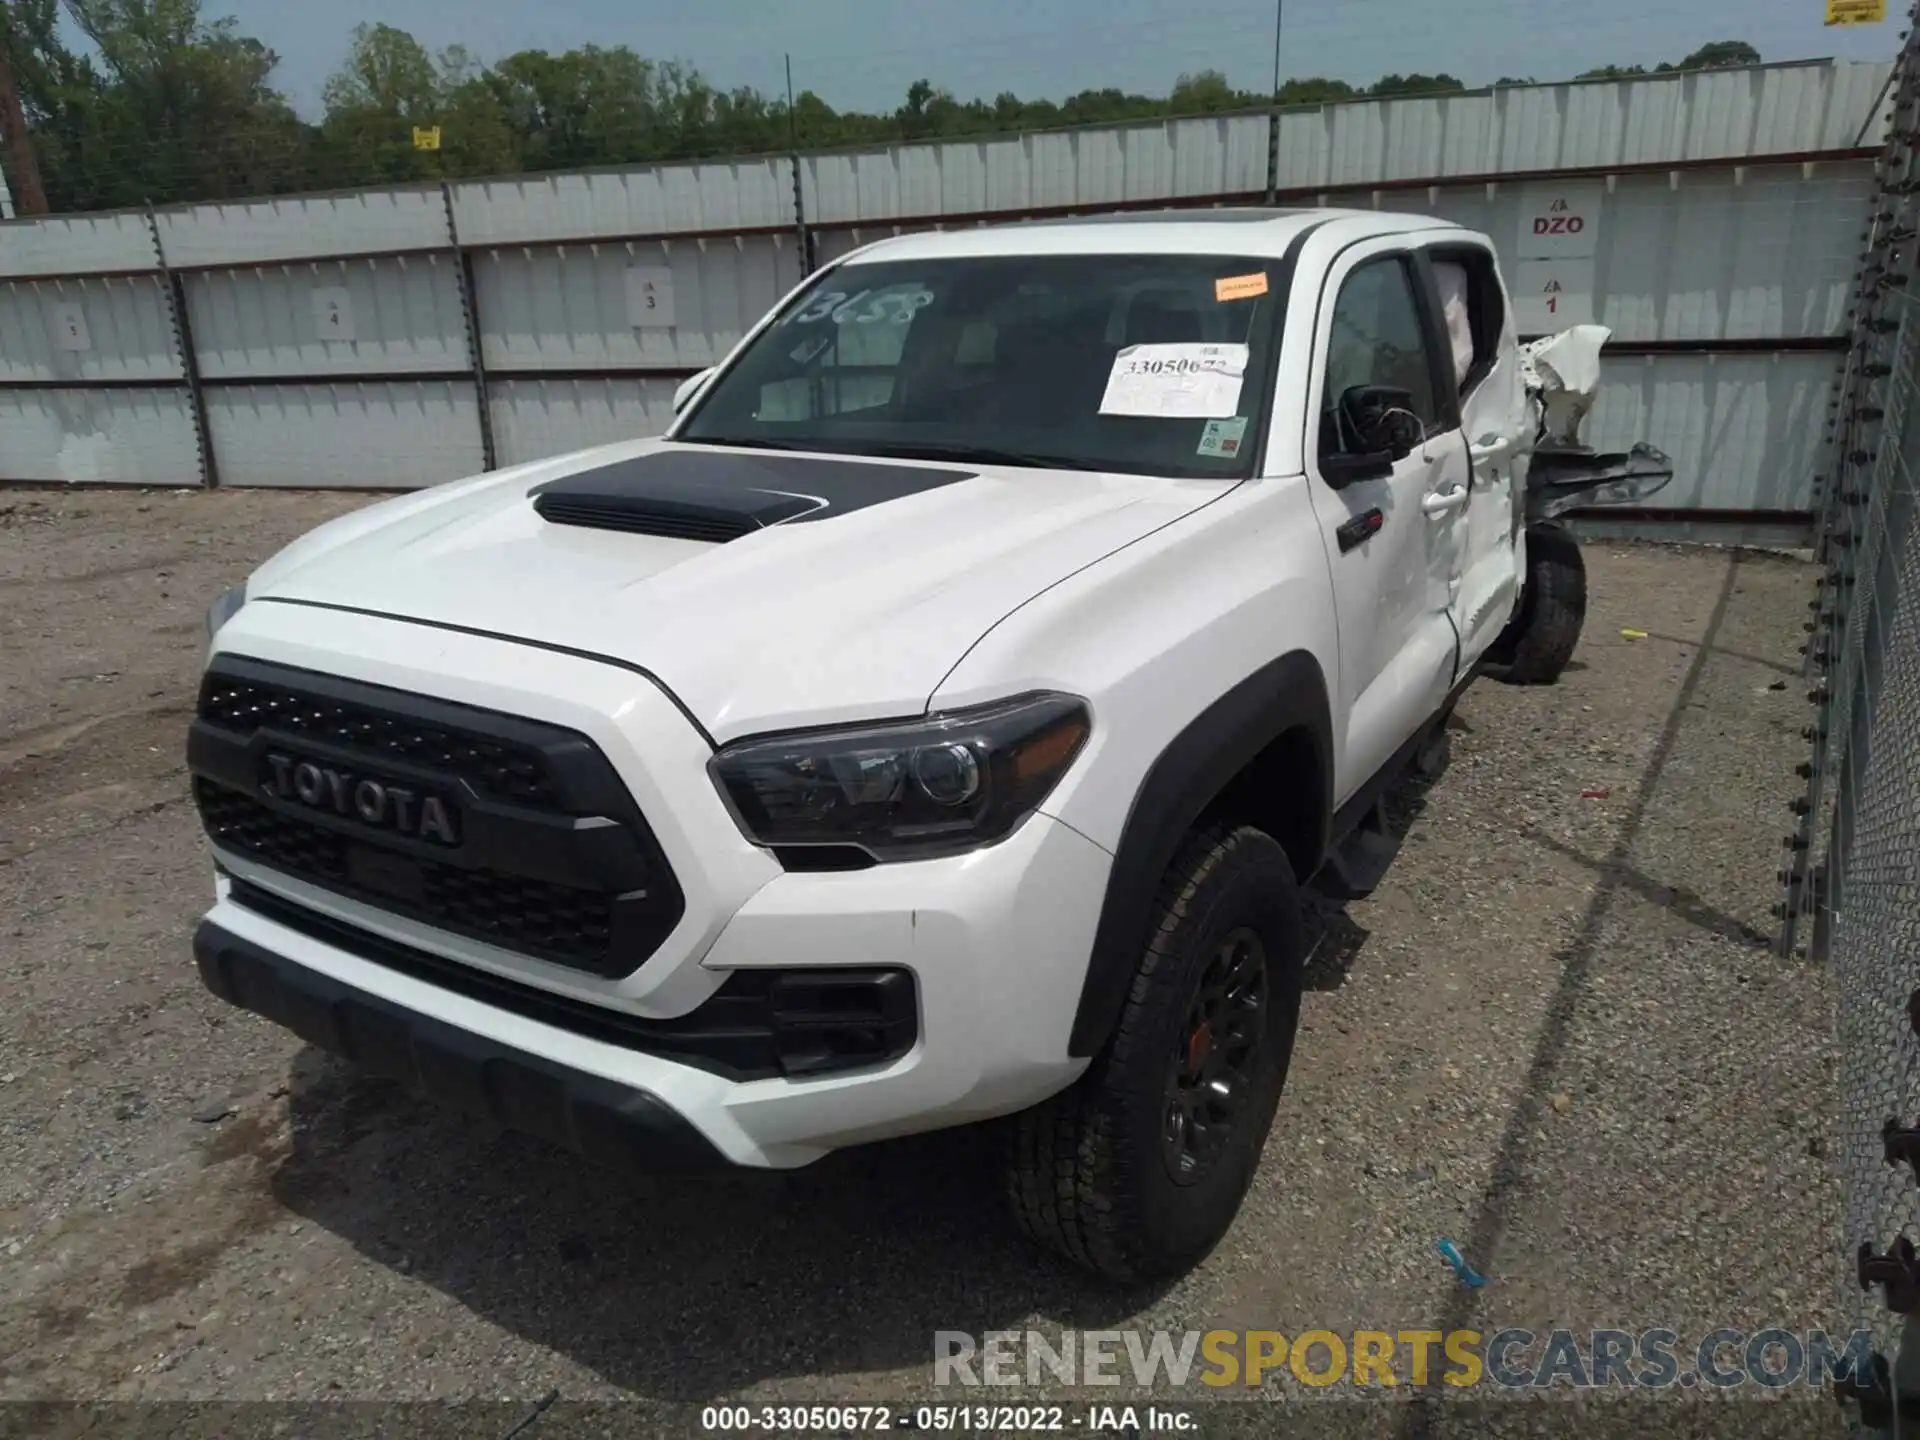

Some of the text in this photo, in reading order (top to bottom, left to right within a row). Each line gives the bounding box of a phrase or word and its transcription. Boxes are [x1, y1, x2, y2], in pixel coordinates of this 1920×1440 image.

[1533, 216, 1584, 235] DZO
[646, 295, 656, 310] 3
[1545, 295, 1557, 314] 1
[330, 312, 339, 326] 4
[267, 754, 457, 843] TOYOTA
